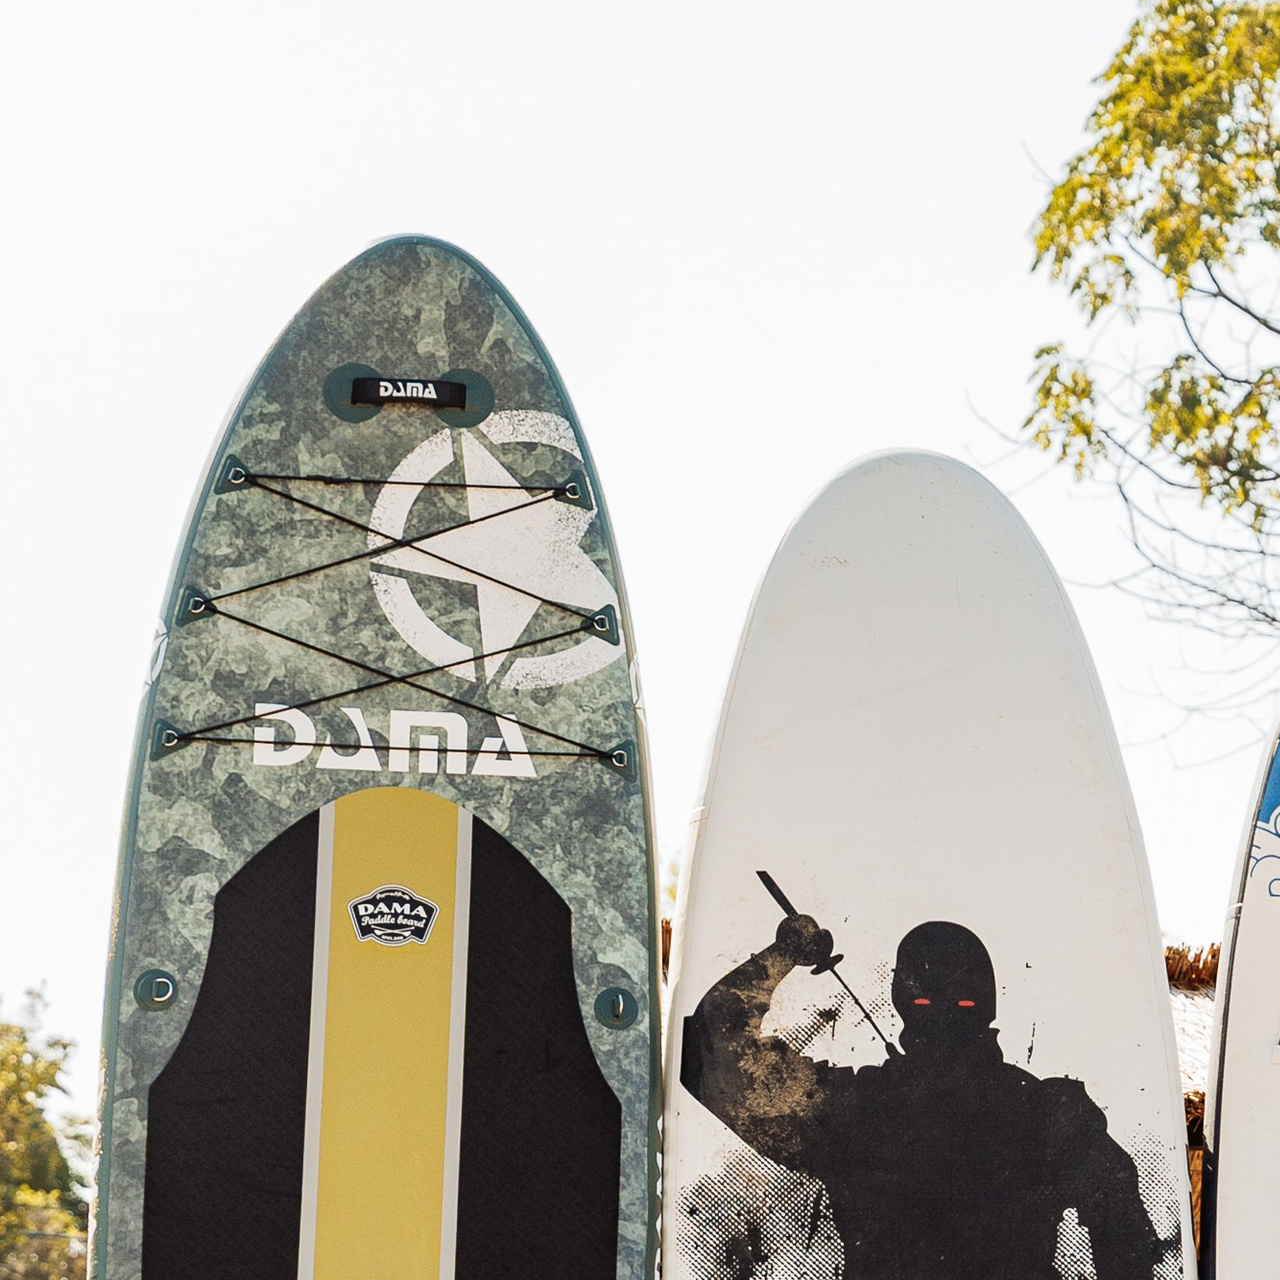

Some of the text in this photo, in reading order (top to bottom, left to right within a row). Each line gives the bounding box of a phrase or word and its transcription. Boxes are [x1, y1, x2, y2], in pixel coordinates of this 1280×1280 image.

[379, 381, 437, 399] DAMA
[253, 702, 538, 778] DAMA
[357, 901, 428, 919] DAMA
[361, 914, 426, 928] Paddle board
